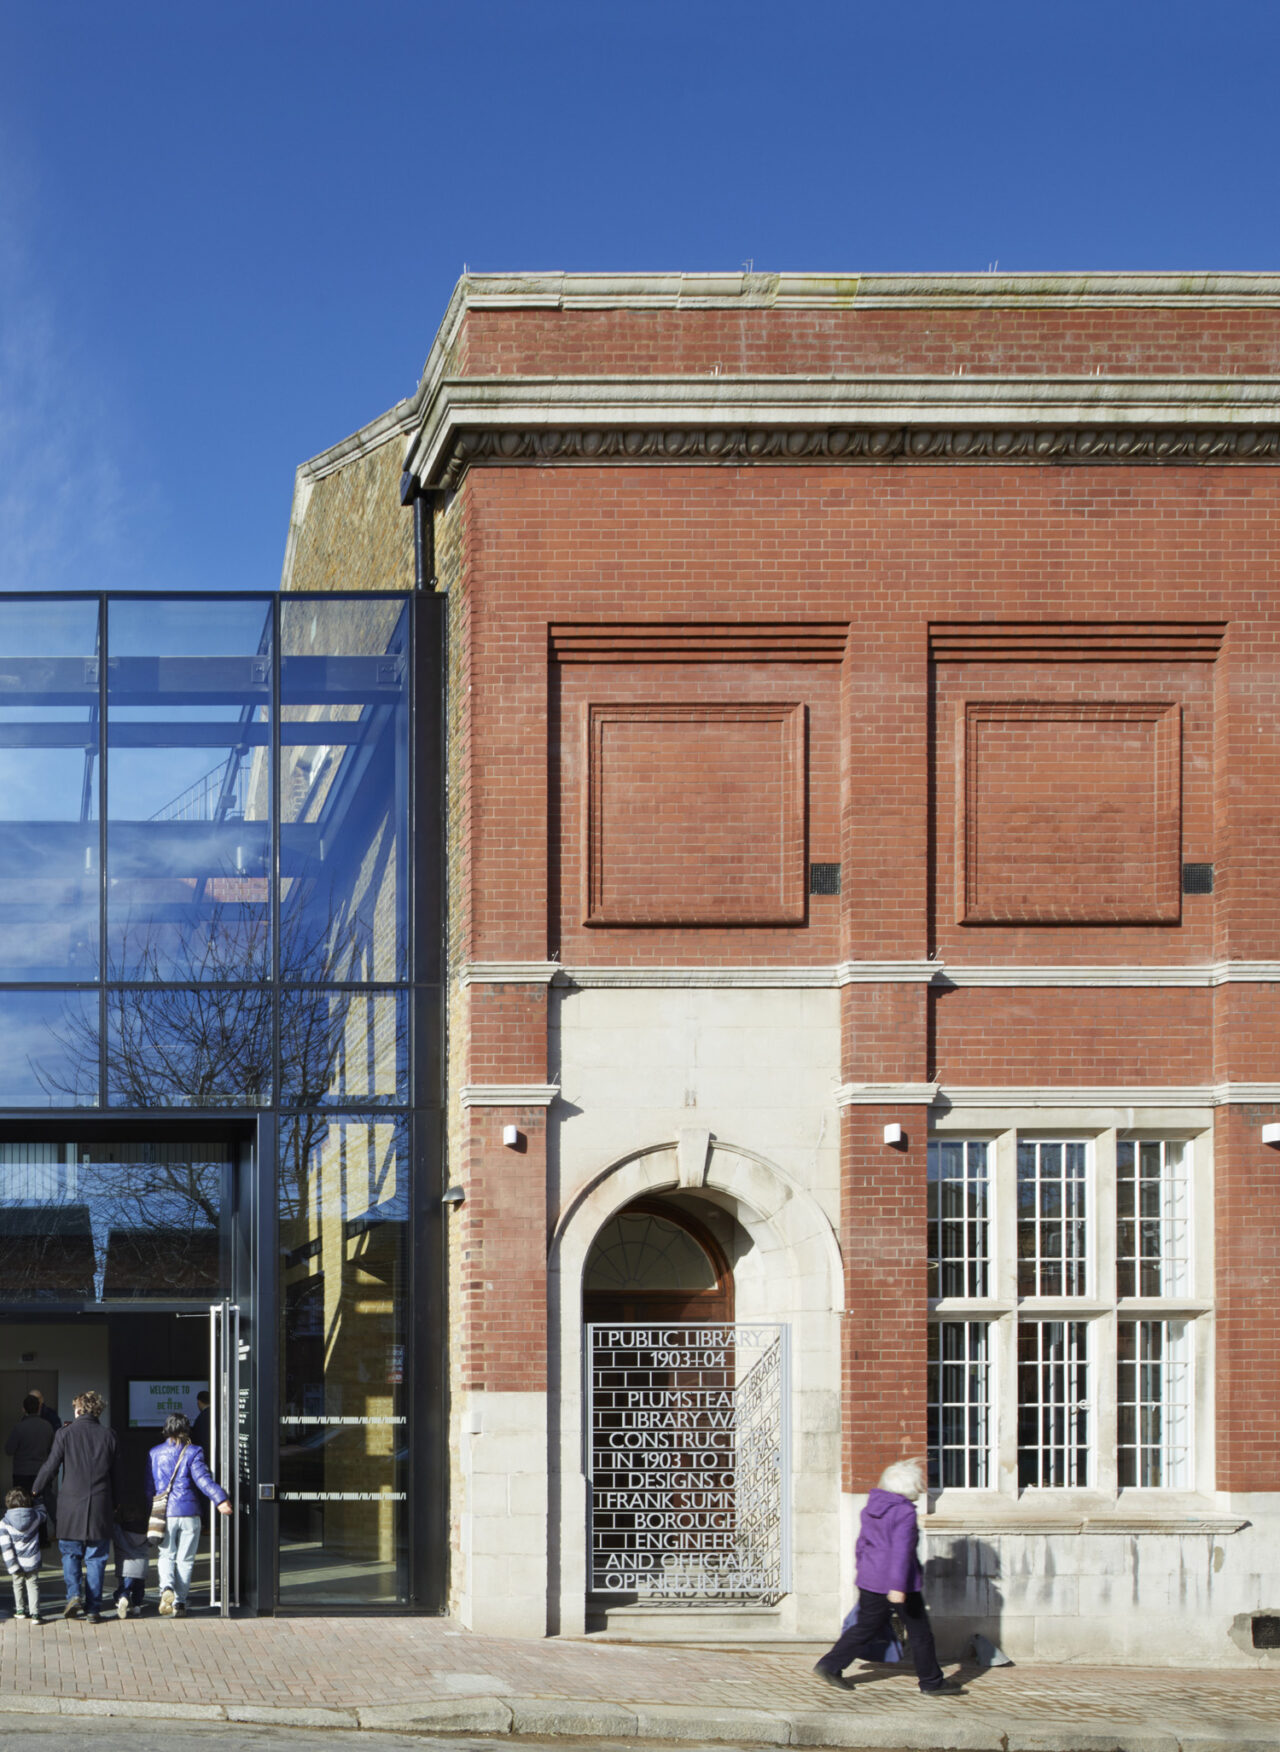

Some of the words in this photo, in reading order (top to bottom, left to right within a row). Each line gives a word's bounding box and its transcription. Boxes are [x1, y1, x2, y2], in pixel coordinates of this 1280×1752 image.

[608, 1331, 678, 1347] PUBLIC
[149, 1385, 180, 1395] WELCOME
[181, 1385, 190, 1395] TO
[622, 1412, 704, 1428] LIBRARY
[612, 1452, 632, 1468] IN
[641, 1452, 681, 1468] 1903
[688, 1452, 717, 1468] TO
[629, 1473, 714, 1488] DESIGNS
[607, 1493, 673, 1509] FRANK
[635, 1513, 741, 1529] BOROUGH
[606, 1553, 654, 1569] AND
[605, 1574, 691, 1589] OPENED
[697, 1574, 719, 1589] IN
[726, 1574, 765, 1589] 1904
